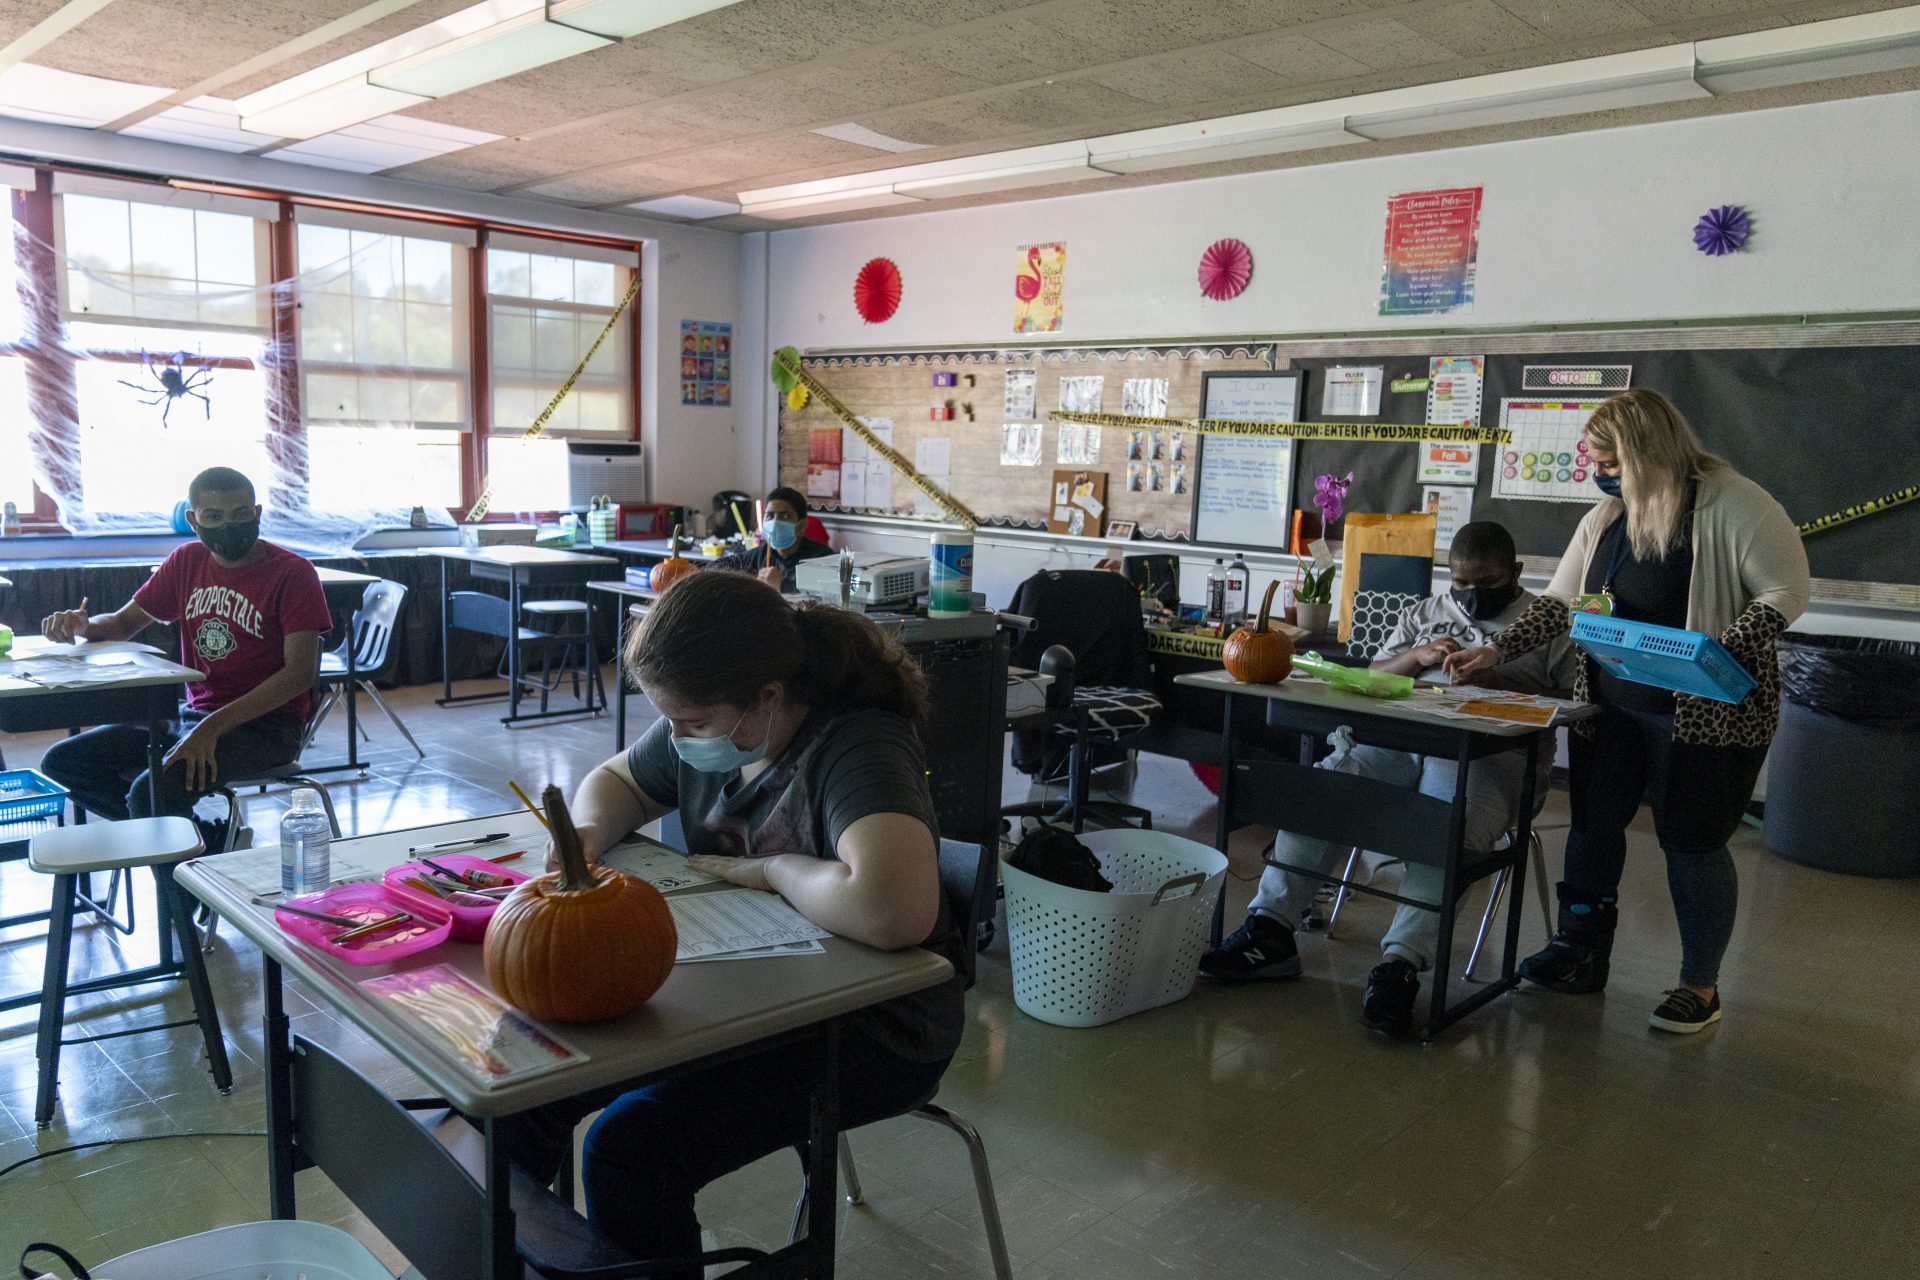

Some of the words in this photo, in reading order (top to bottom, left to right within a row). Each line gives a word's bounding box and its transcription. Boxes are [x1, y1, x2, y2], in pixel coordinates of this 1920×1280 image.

[1550, 371, 1601, 384] OCTOBER
[1394, 381, 1427, 392] Summer
[1217, 420, 1227, 433] IF
[1228, 421, 1250, 434] YOU
[1250, 422, 1276, 435] DARE
[1276, 423, 1323, 438] CAUTION:
[1324, 424, 1358, 438] ENTER
[1361, 425, 1372, 438] IF
[1373, 425, 1398, 440] YOU
[1398, 426, 1428, 440] DARE
[1430, 427, 1484, 441] CAUTION:
[1441, 451, 1457, 460] Fall
[1151, 633, 1183, 650] DARE
[1243, 947, 1266, 965] N
